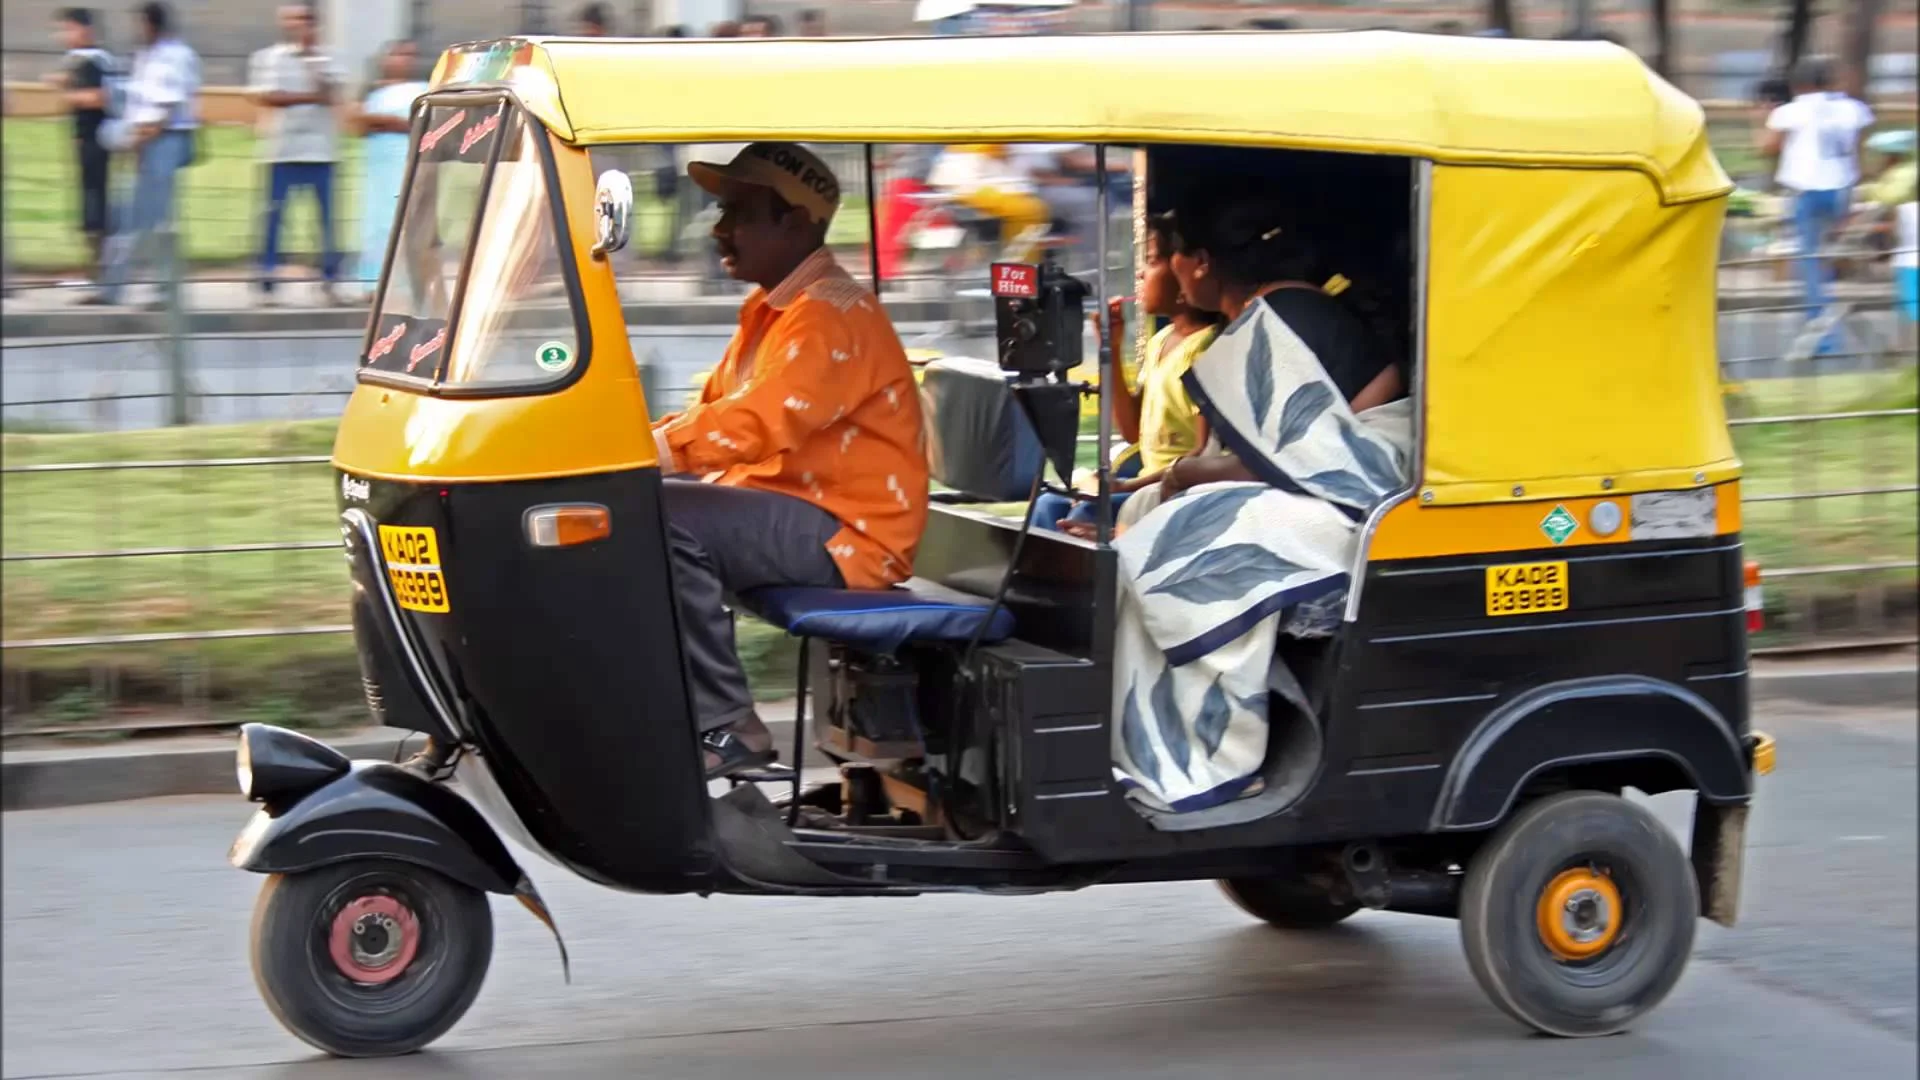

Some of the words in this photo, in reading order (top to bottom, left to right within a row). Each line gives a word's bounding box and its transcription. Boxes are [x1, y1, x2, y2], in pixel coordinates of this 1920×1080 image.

[1001, 266, 1026, 280] For
[384, 533, 431, 564] KA02
[1496, 565, 1557, 587] KA02
